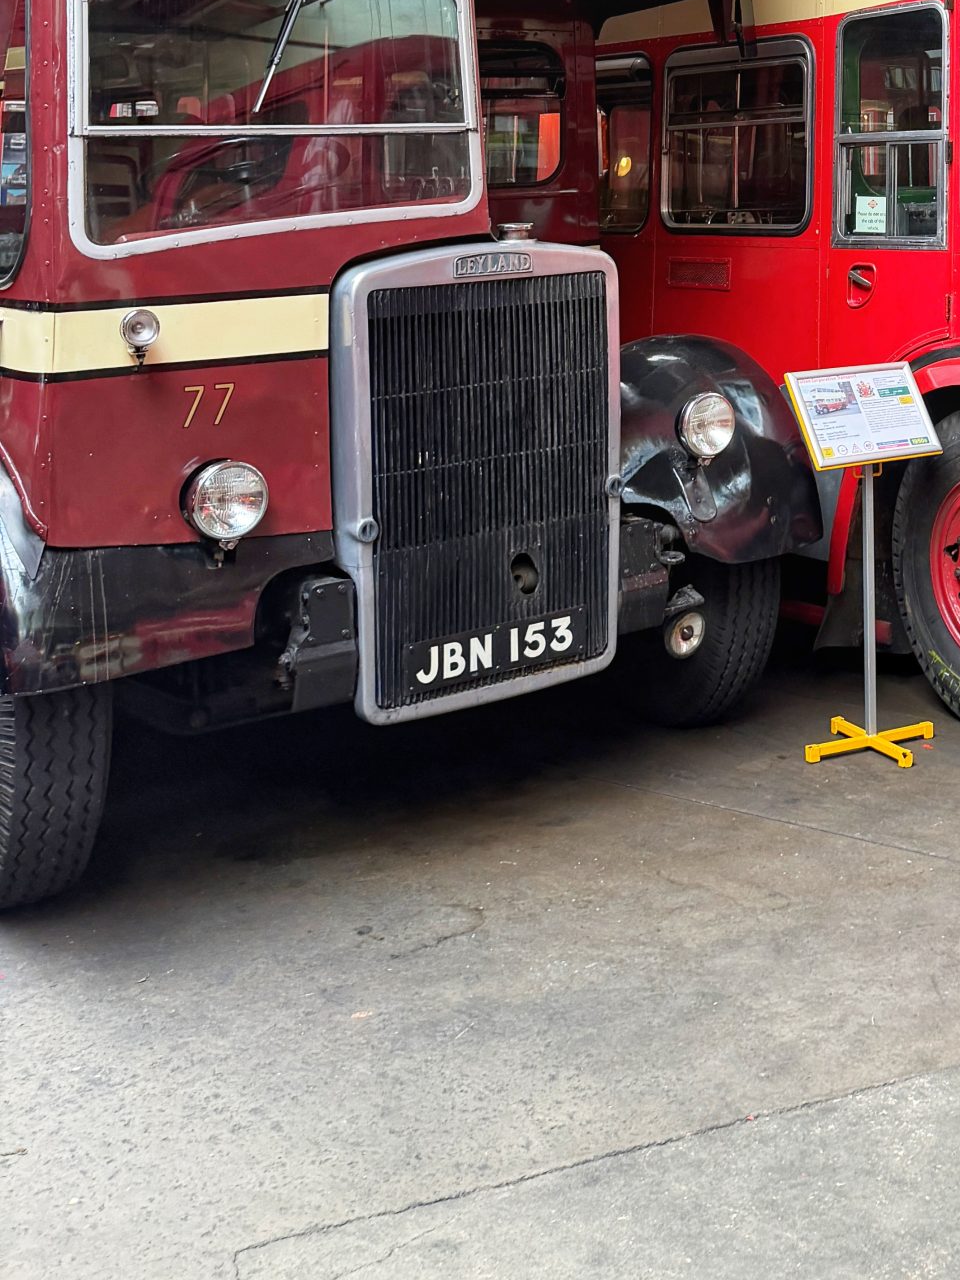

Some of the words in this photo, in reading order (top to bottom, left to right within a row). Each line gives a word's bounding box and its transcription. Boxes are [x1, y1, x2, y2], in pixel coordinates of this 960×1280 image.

[457, 254, 531, 275] LEYLAND
[183, 382, 235, 428] 77
[416, 633, 493, 685] JBN
[510, 615, 573, 662] 153
